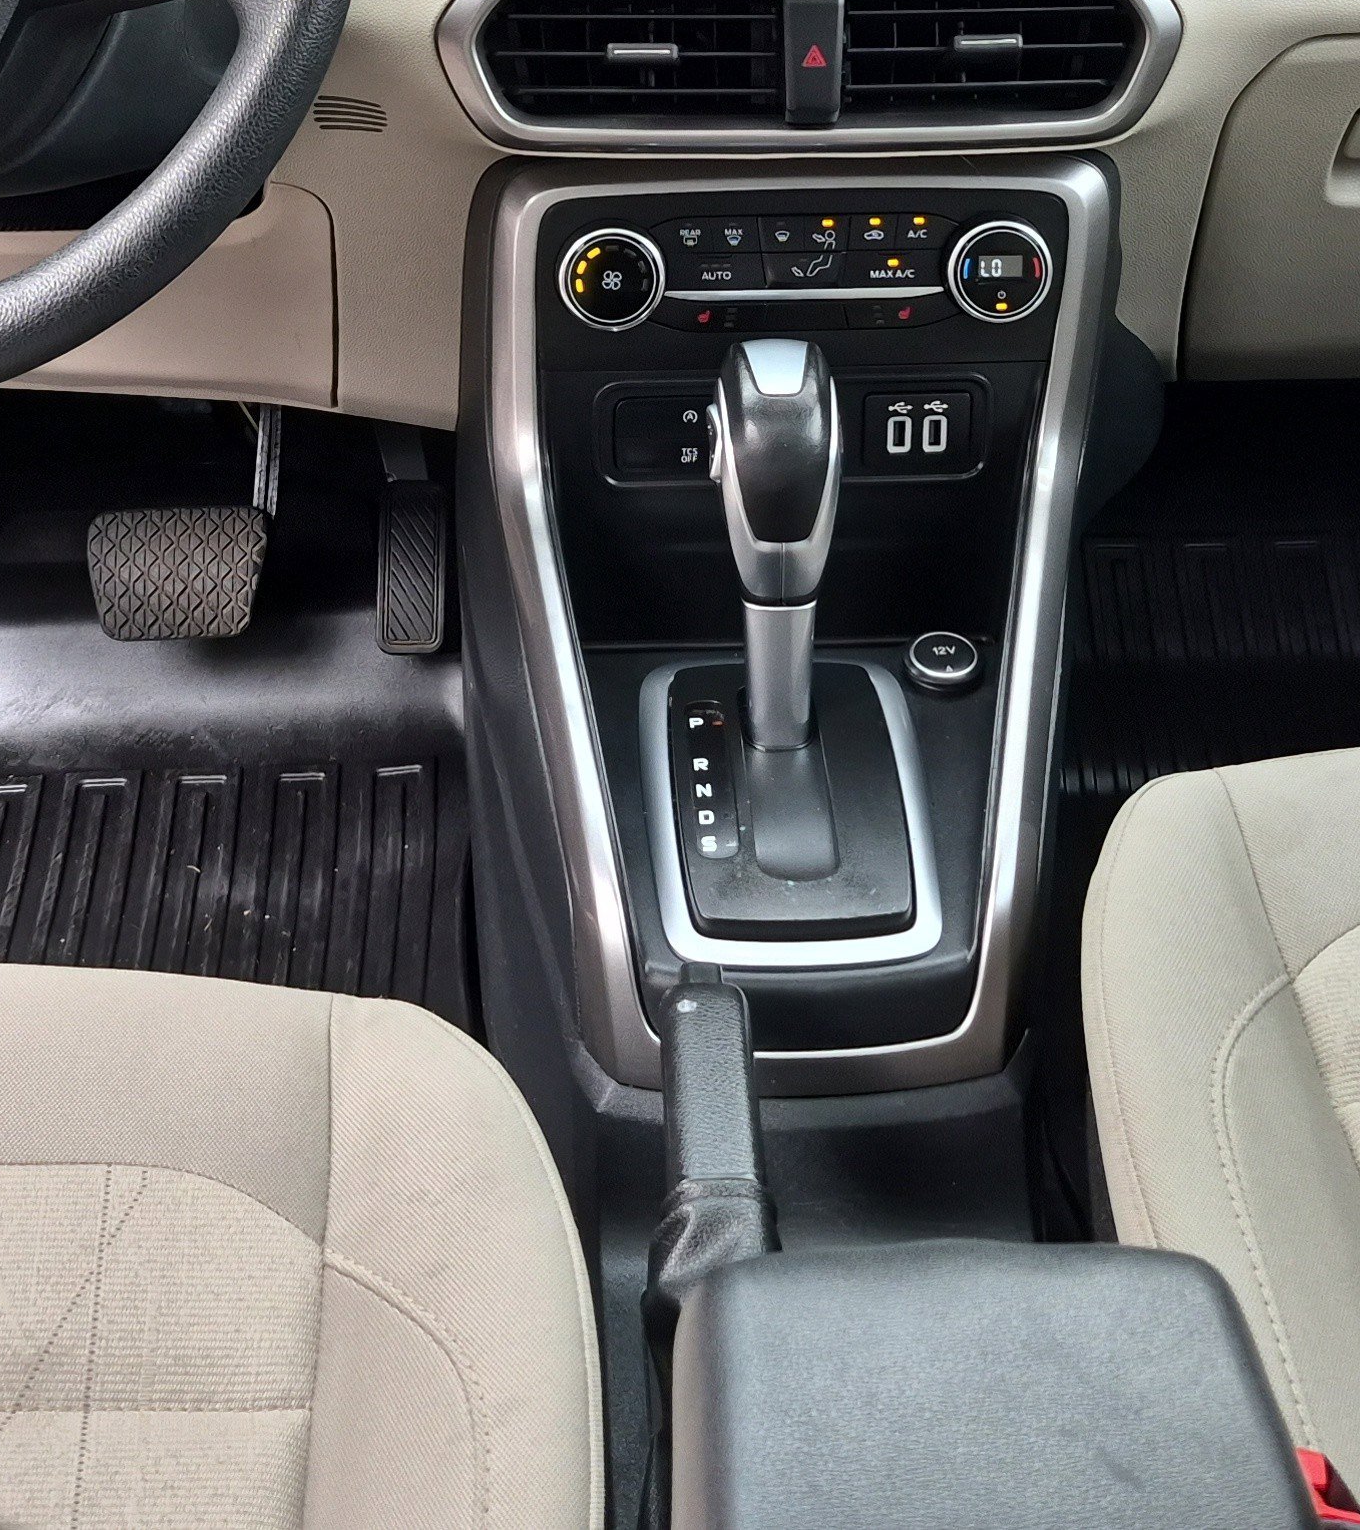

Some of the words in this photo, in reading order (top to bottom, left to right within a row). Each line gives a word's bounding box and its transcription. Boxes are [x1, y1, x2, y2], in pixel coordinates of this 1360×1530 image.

[907, 229, 928, 239] A/C
[702, 271, 732, 280] AUTO
[870, 270, 893, 279] MAX
[895, 269, 916, 279] A/C
[681, 447, 698, 456] TCS
[932, 645, 956, 656] 12V
[689, 717, 704, 729] P
[692, 757, 709, 771] R
[695, 783, 713, 798] N
[698, 810, 715, 825] D
[701, 835, 718, 852] S
